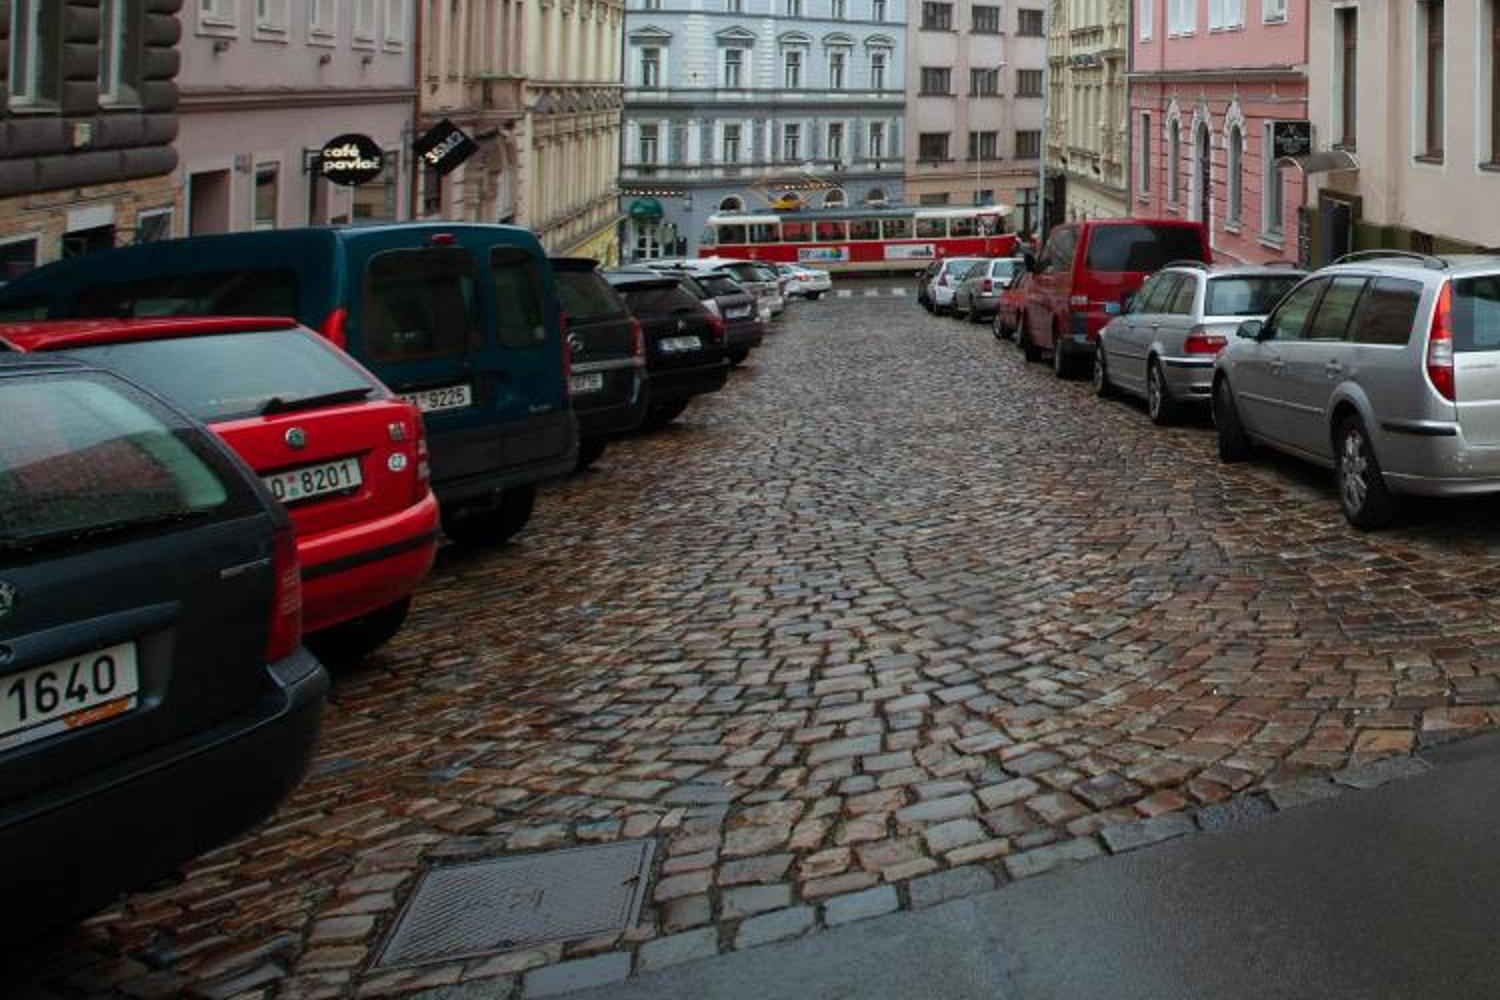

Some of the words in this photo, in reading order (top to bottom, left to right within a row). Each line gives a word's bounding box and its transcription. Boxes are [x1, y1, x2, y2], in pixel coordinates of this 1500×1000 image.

[323, 143, 360, 158] café
[301, 463, 352, 493] 8201
[7, 654, 116, 721] 1640
